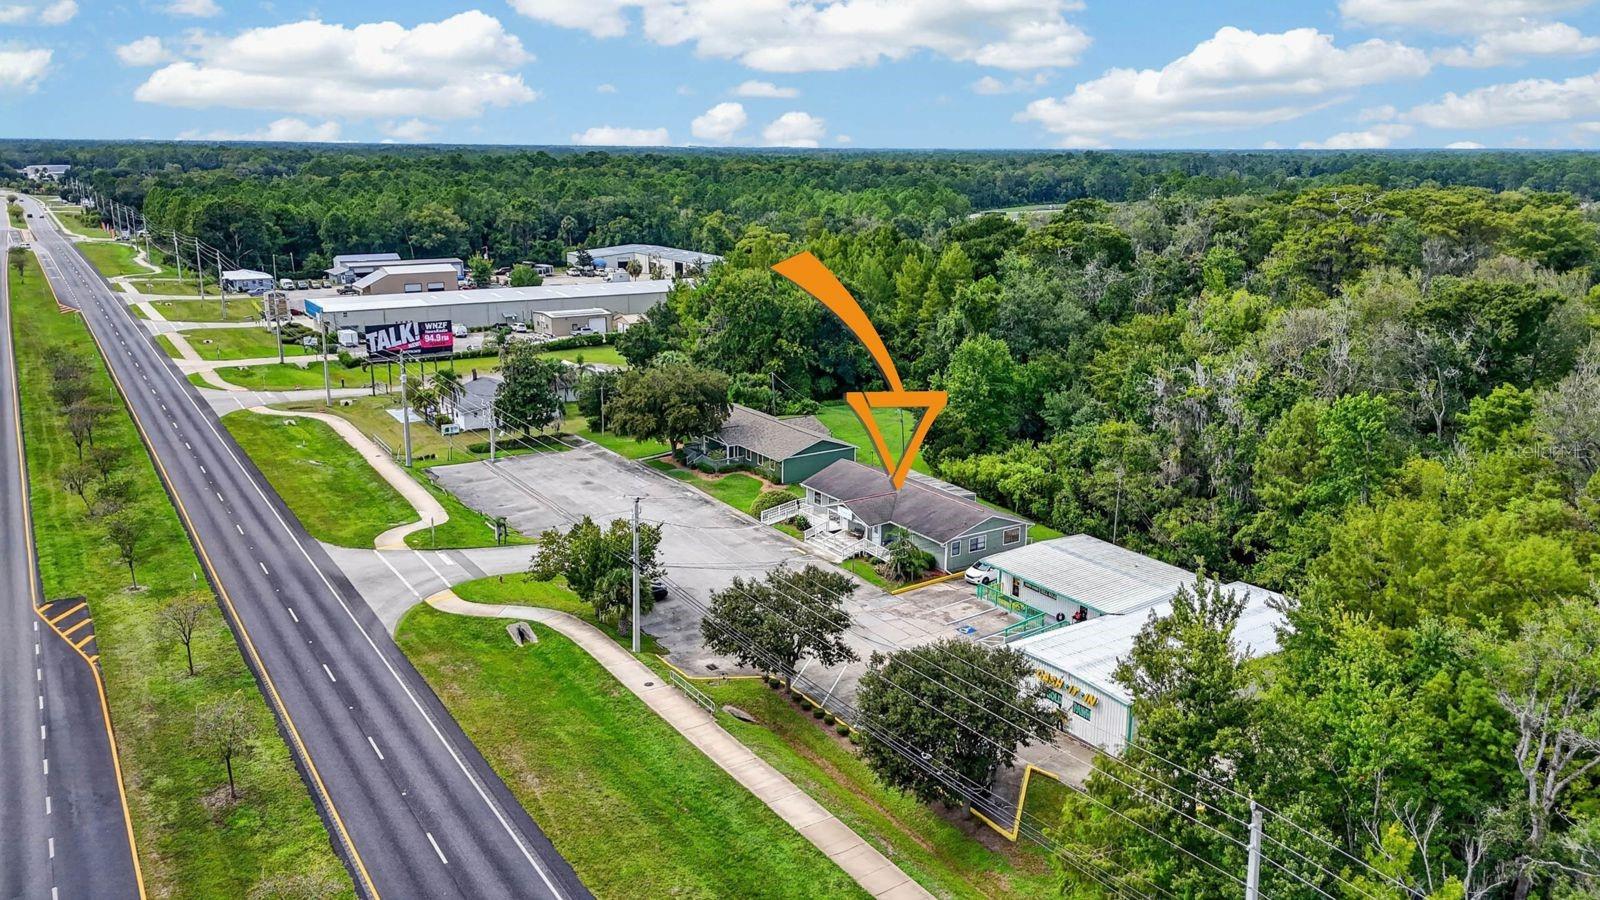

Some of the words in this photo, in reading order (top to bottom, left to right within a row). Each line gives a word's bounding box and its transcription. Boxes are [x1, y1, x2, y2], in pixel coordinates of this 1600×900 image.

[425, 322, 447, 330] WNZF
[366, 322, 420, 353] TALK!
[424, 334, 441, 342] 94.9
